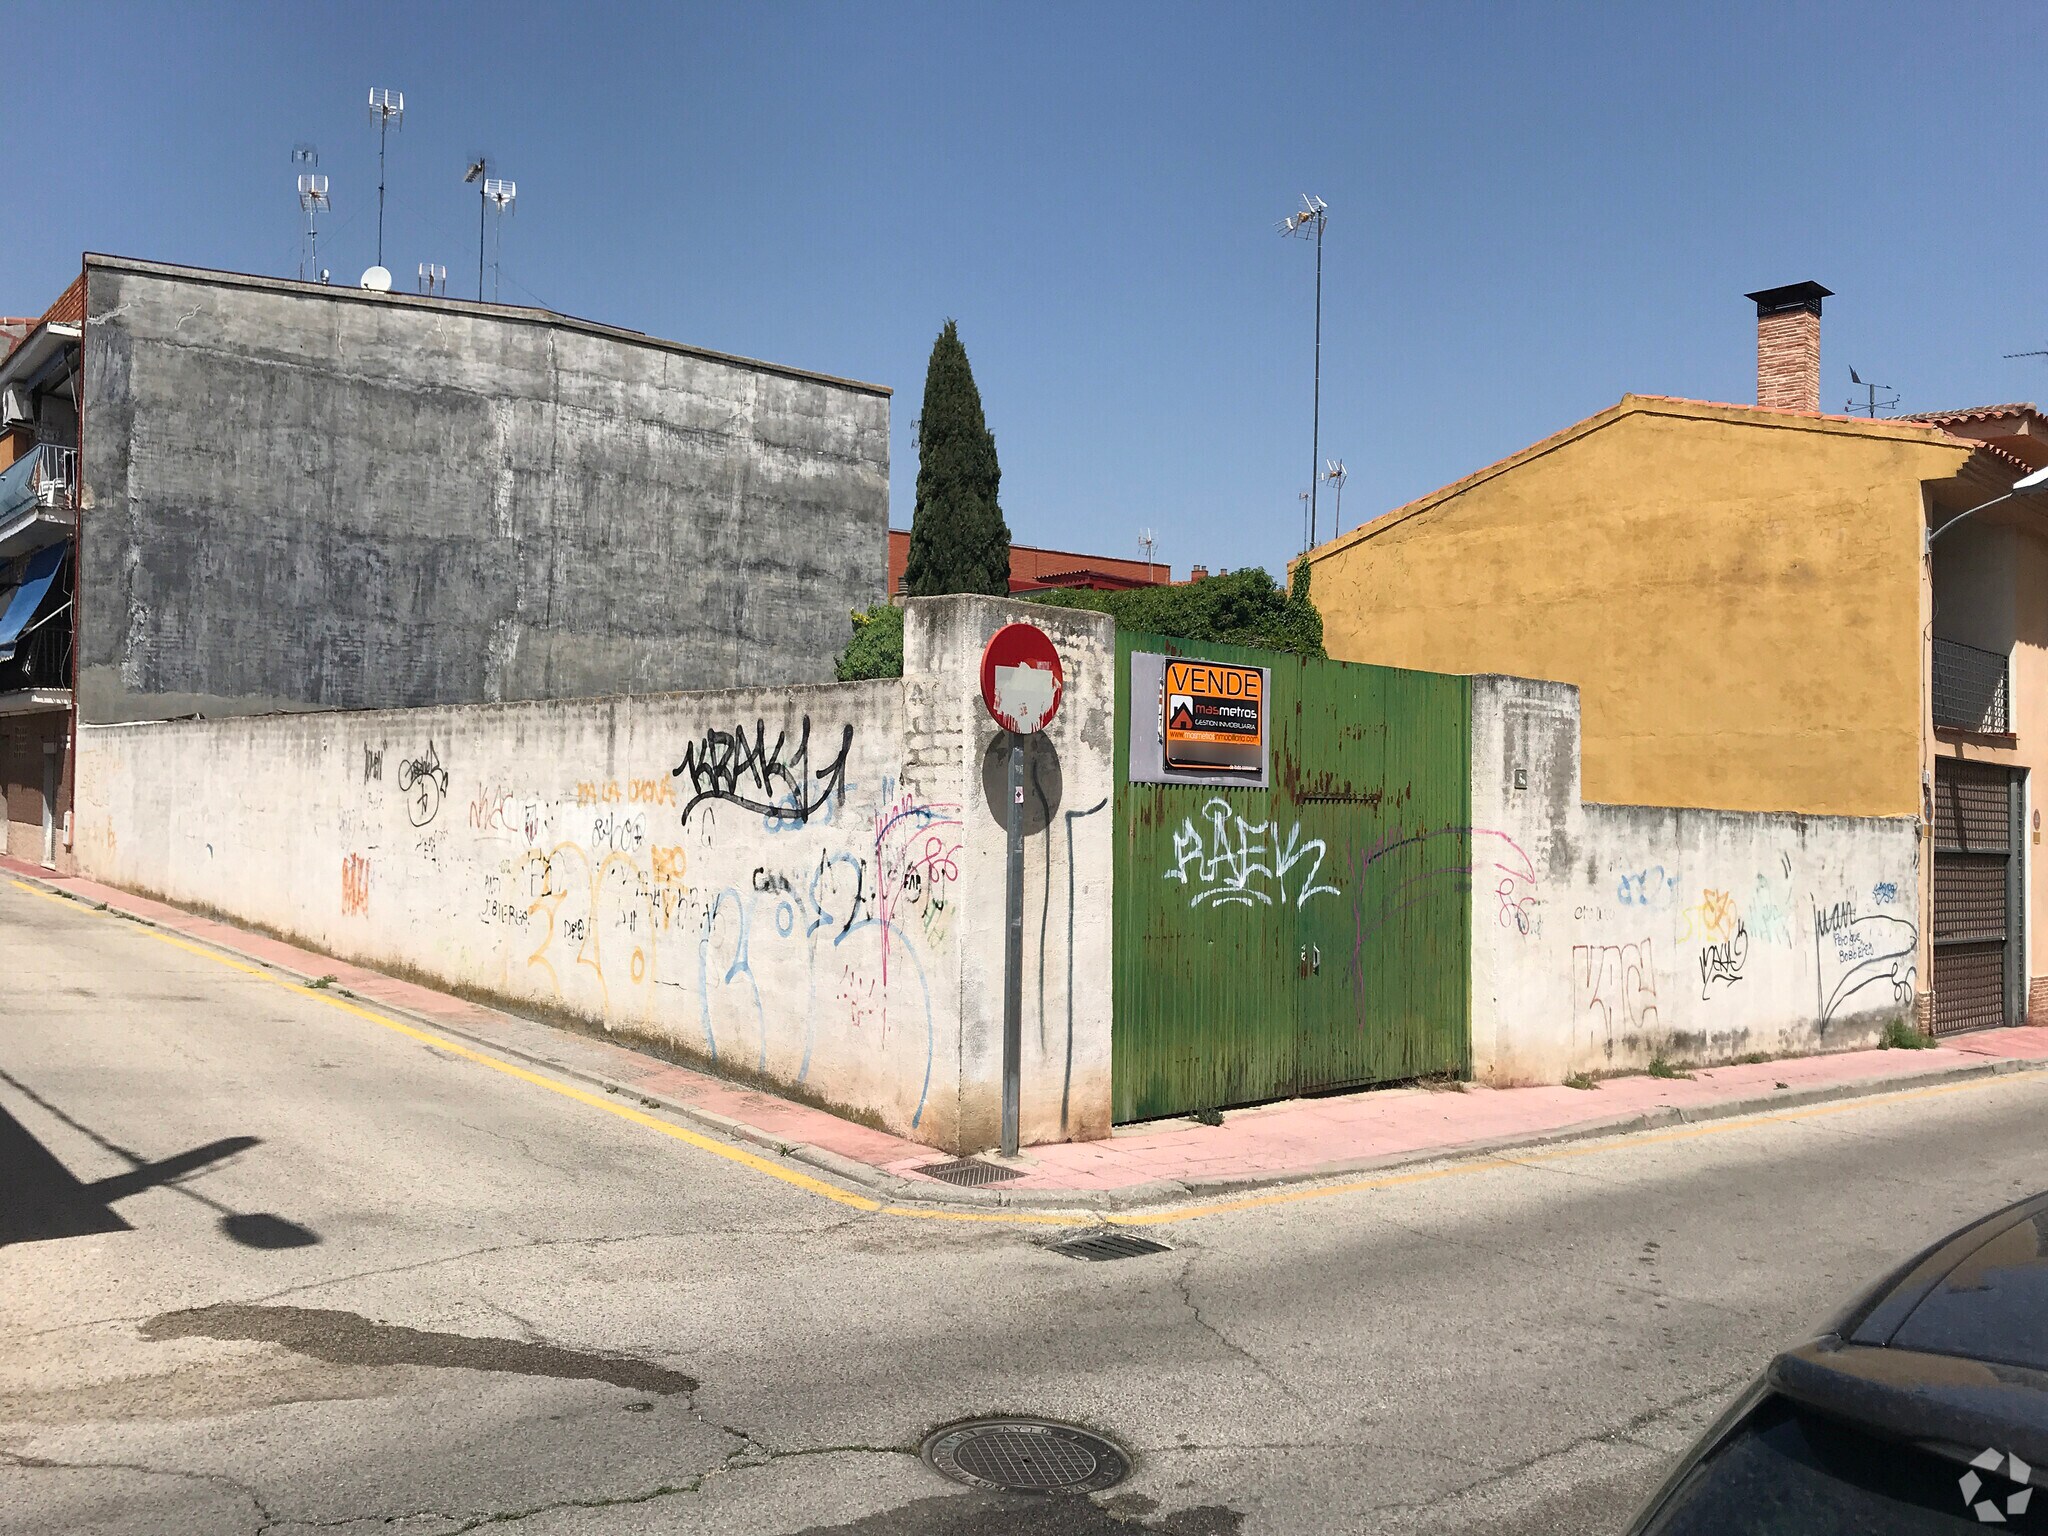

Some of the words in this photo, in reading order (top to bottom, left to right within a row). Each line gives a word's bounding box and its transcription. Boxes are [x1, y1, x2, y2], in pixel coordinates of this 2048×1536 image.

[1172, 666, 1258, 697] VENDE
[1195, 703, 1257, 719] masmetros
[1219, 720, 1256, 731] INMOBILIARIA
